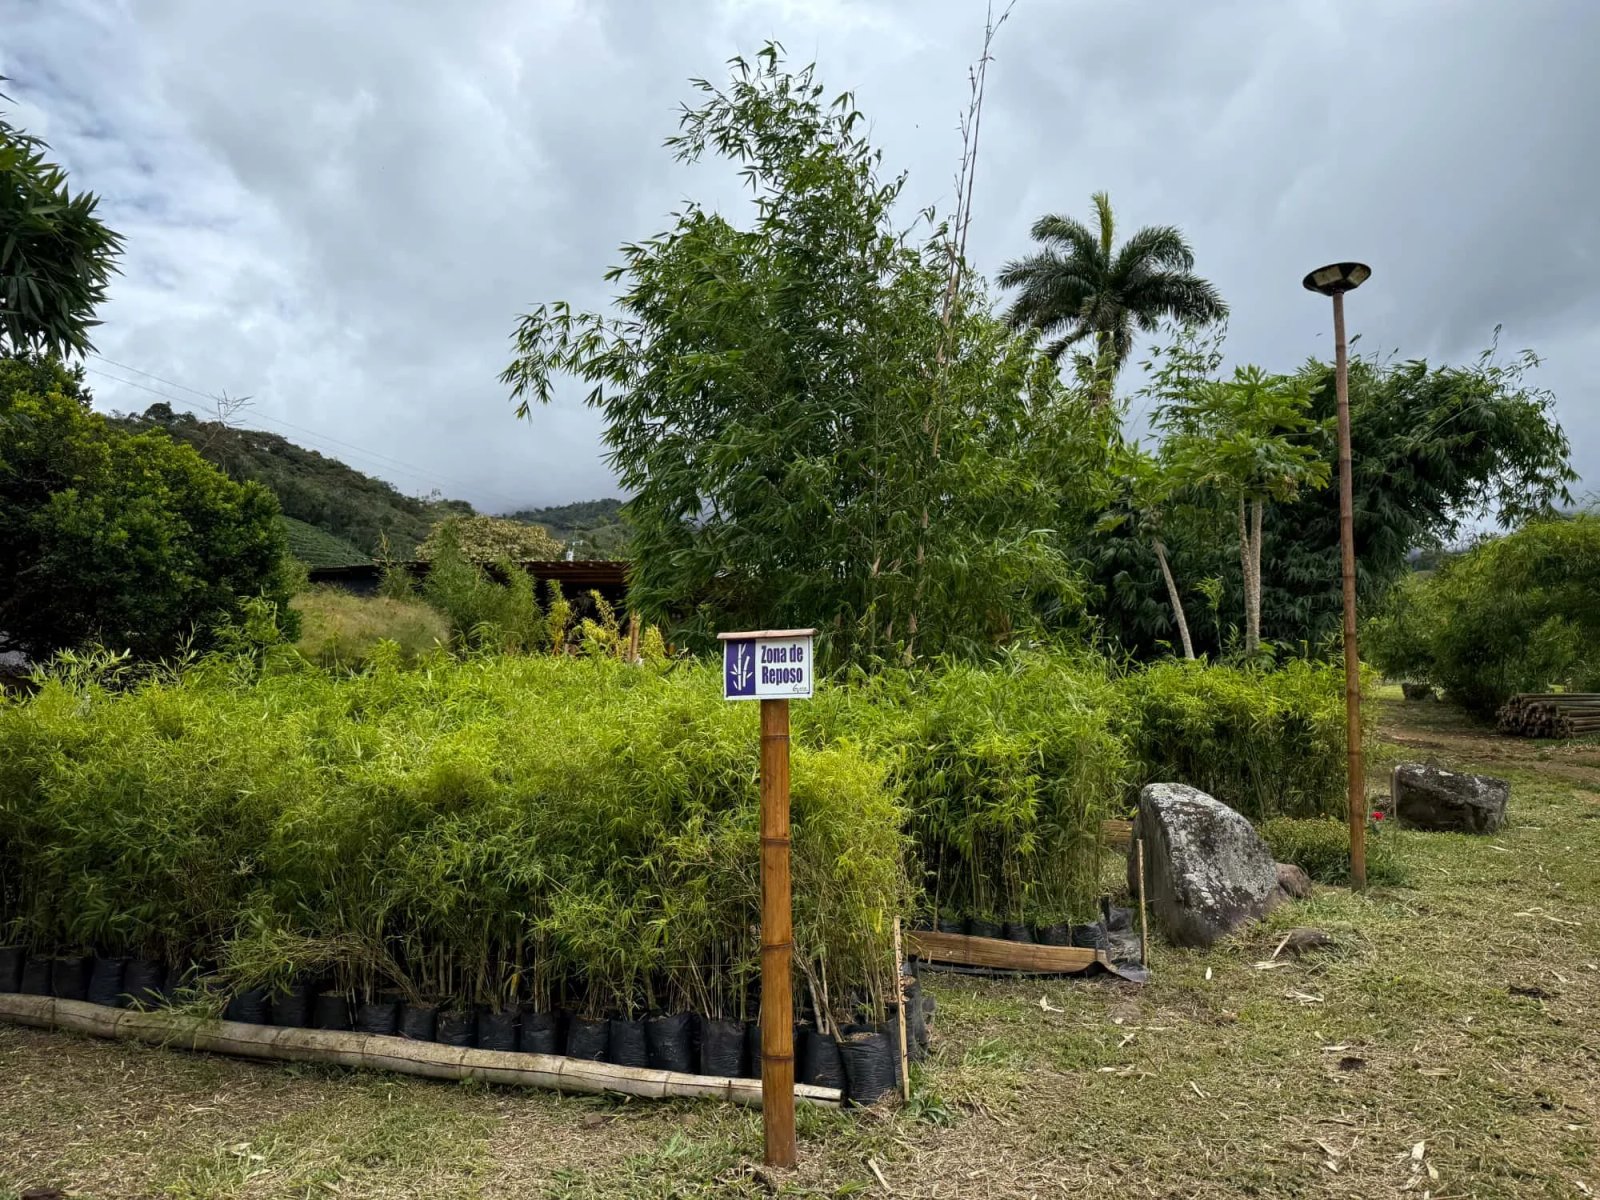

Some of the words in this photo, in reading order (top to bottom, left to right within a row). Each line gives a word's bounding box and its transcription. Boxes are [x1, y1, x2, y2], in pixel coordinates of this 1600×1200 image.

[761, 645, 786, 663] Zona
[789, 644, 803, 662] de
[762, 666, 803, 685] Reposo
